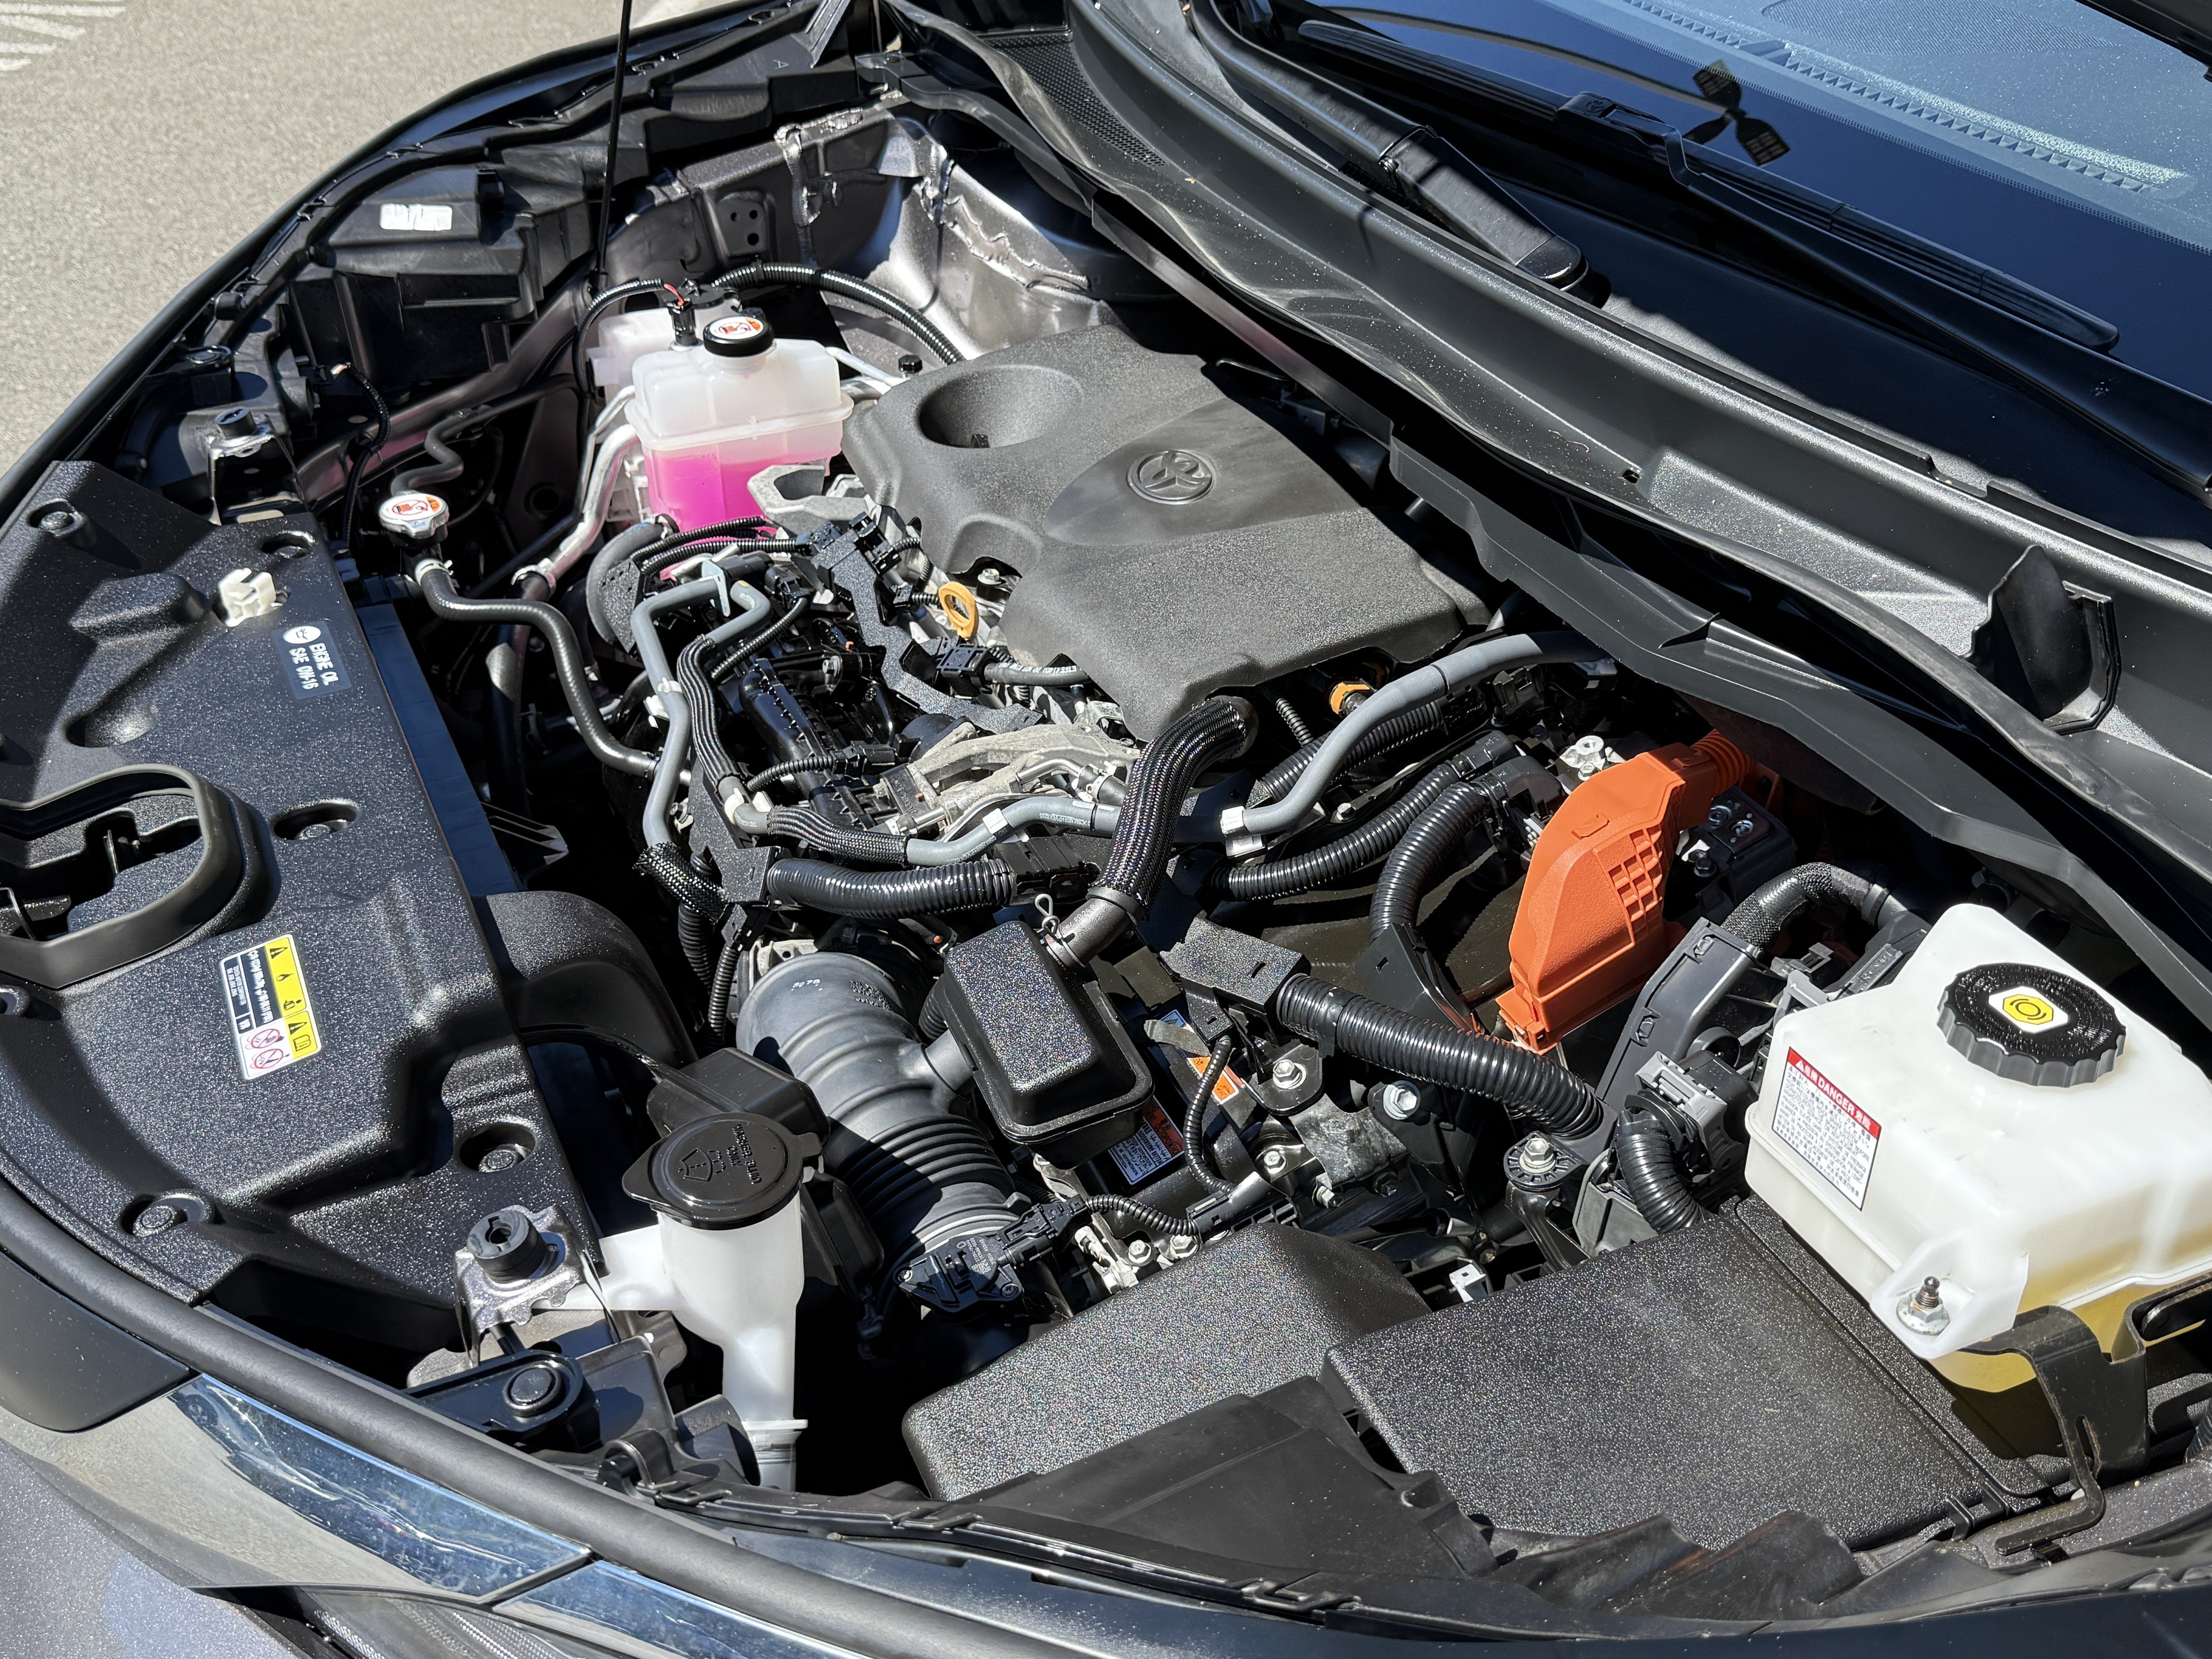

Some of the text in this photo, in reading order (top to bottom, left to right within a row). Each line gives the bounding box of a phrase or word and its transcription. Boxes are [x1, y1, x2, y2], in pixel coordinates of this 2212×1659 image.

[289, 647, 310, 664] SAE
[309, 642, 339, 686] ENGINE OIL
[1818, 1078, 1855, 1115] DANGER
[727, 1146, 742, 1166] ONLY
[732, 1124, 762, 1184] WASHER FLUID
